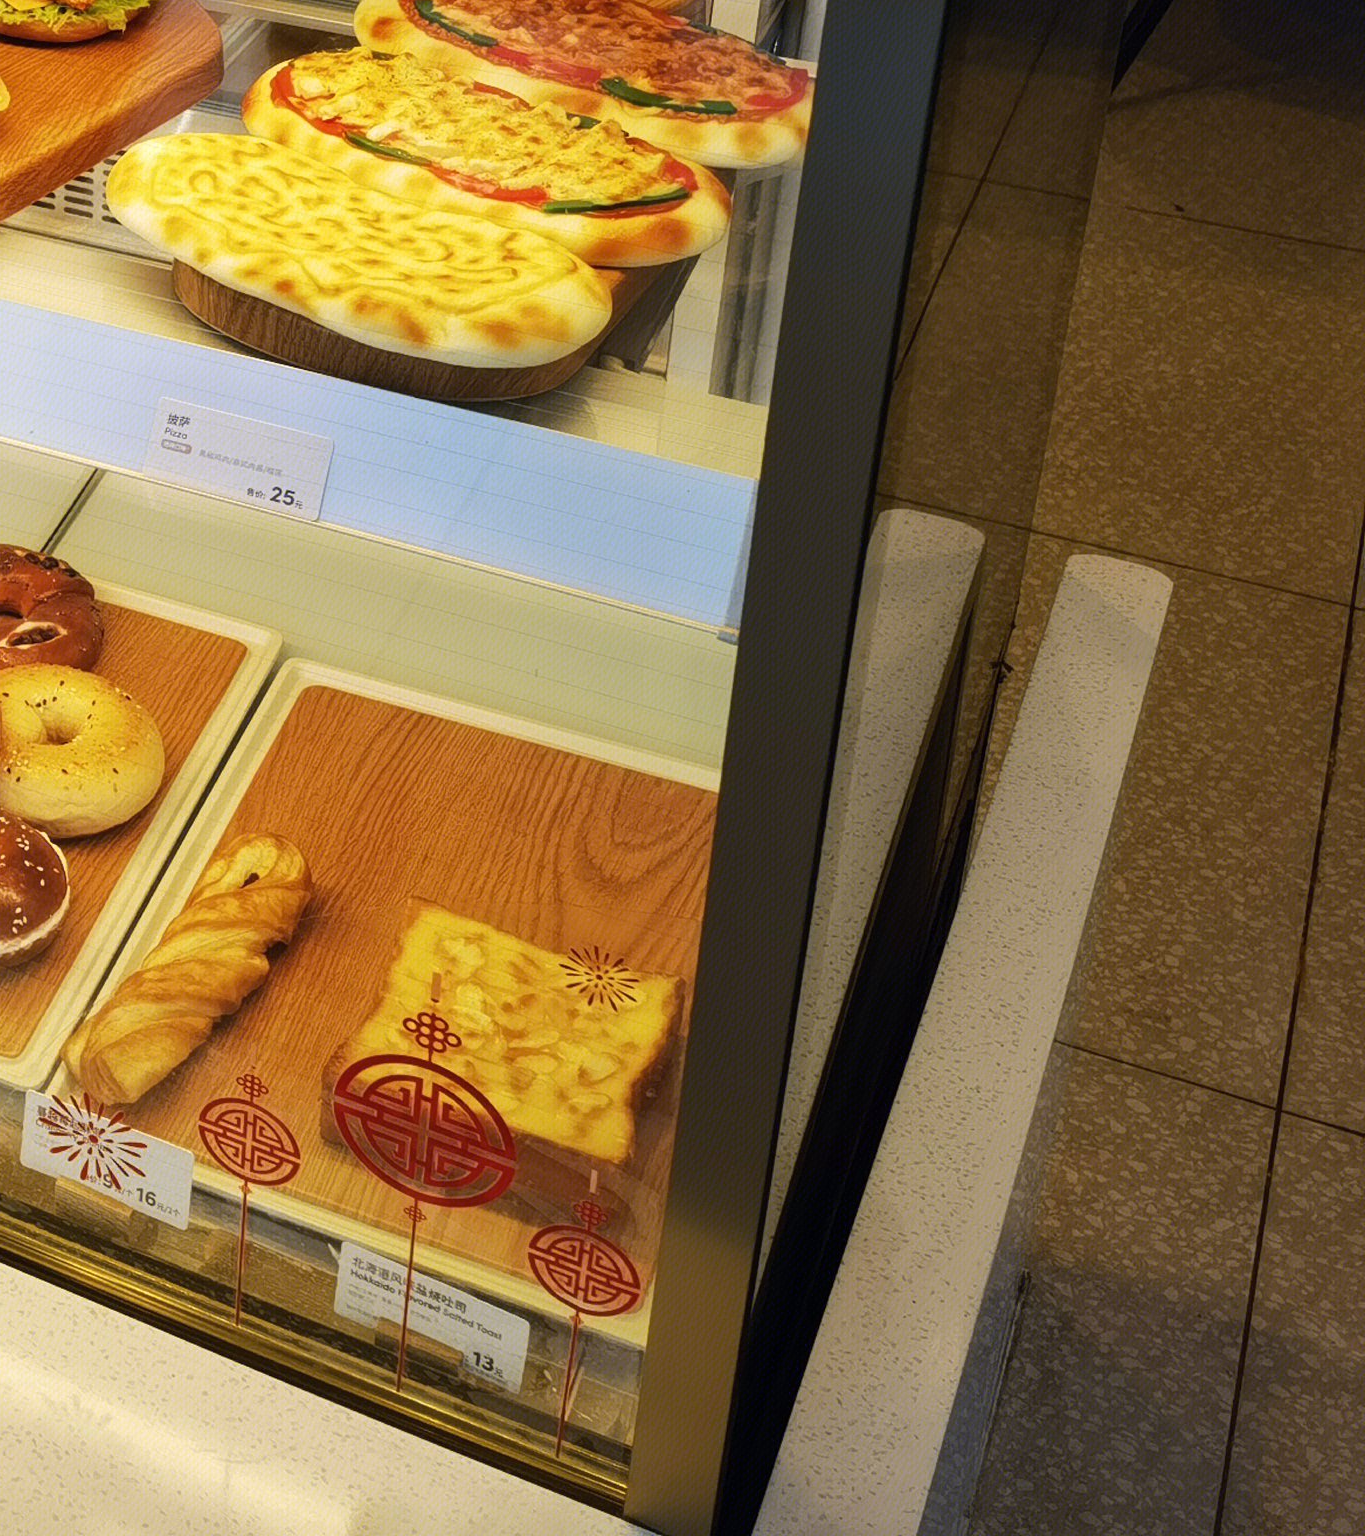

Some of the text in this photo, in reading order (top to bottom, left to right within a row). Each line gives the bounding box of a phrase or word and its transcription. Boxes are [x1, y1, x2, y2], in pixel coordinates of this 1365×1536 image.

[165, 427, 188, 440] Pizza
[350, 1269, 503, 1341] Hokkaido Salted Toast
[352, 1256, 467, 1314] 北海道风盐烧吐司
